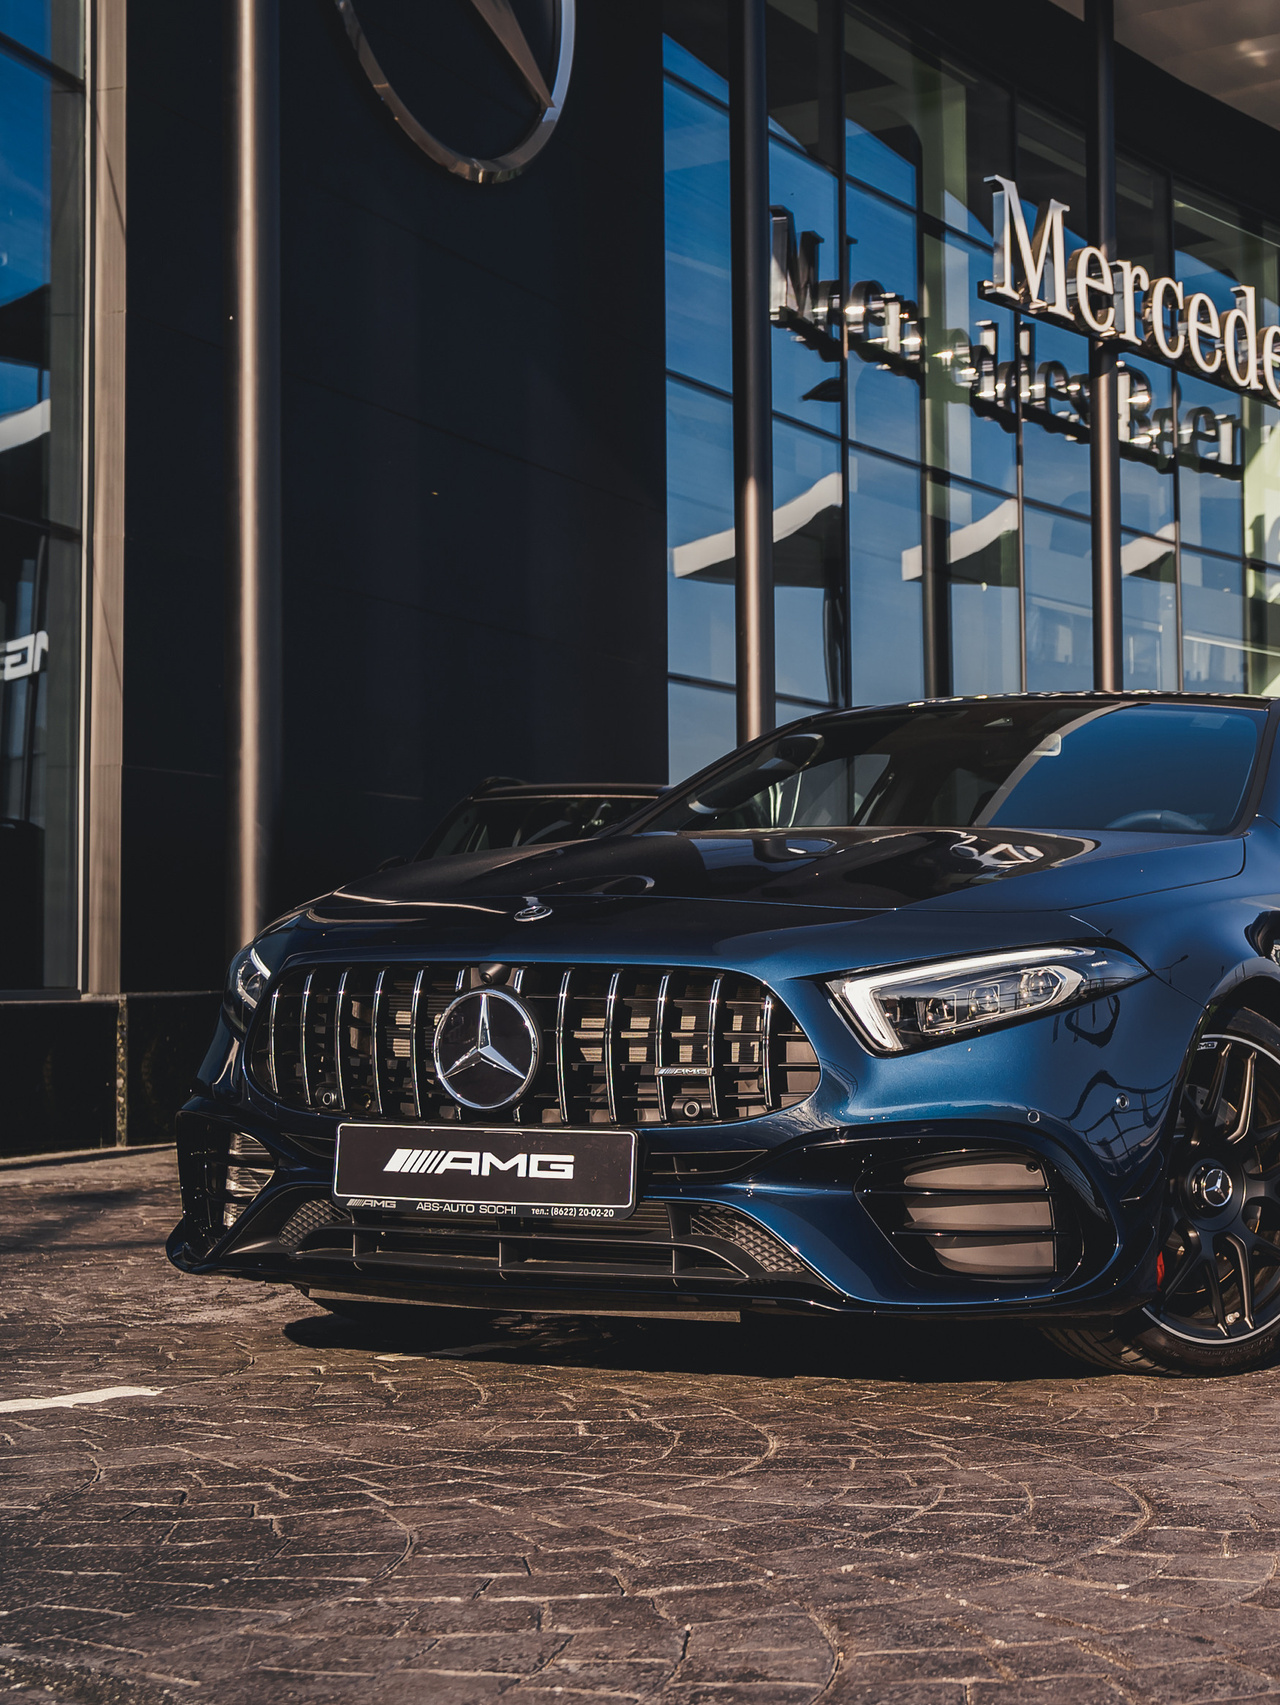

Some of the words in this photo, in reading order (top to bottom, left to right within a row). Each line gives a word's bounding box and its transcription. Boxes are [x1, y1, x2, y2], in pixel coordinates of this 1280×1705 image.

[433, 1150, 575, 1180] AMG
[361, 1199, 397, 1209] AMG
[416, 1201, 475, 1213] ABS-AUTO
[479, 1204, 517, 1215] SOCHI
[531, 1207, 550, 1216] тел.:
[550, 1206, 577, 1218] (8622)
[578, 1208, 615, 1218] 20-02-20
